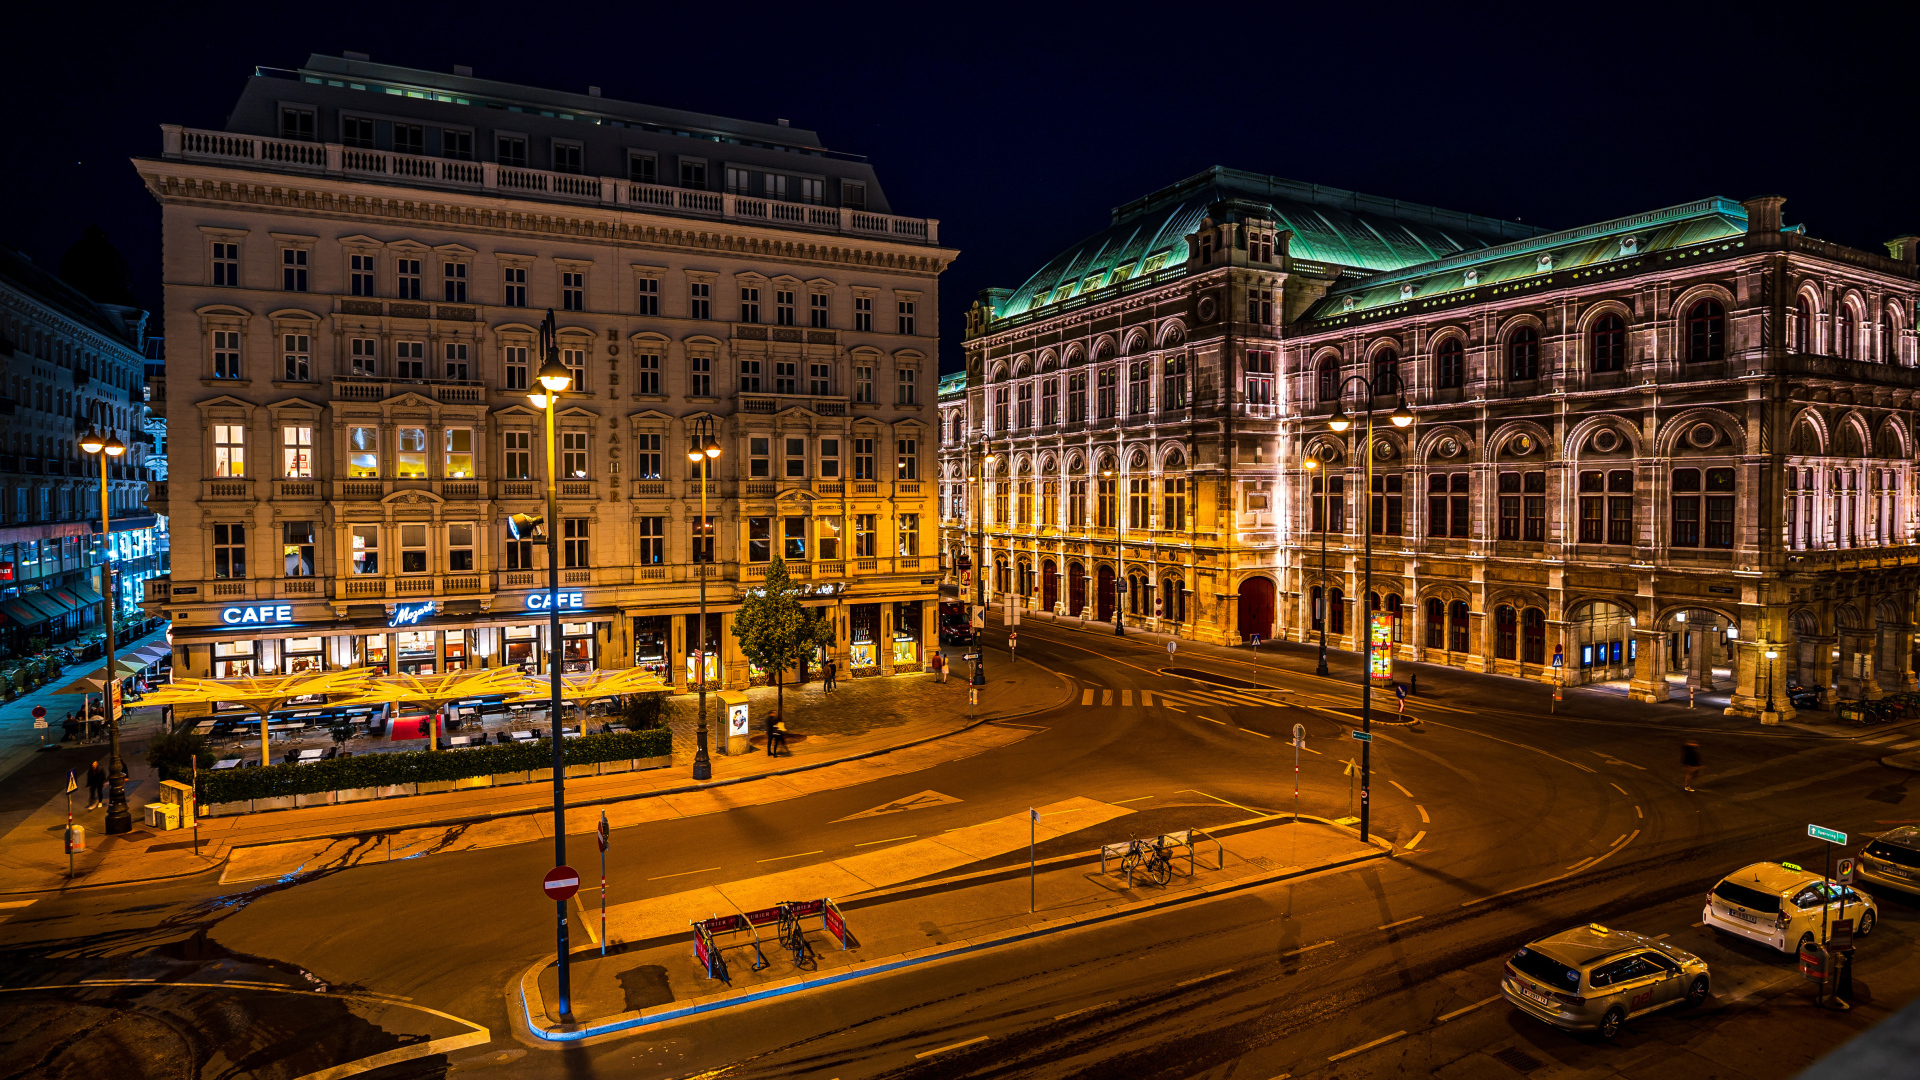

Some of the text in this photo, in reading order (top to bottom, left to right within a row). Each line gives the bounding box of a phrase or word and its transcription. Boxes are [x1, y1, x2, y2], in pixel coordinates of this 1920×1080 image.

[608, 329, 621, 503] HOTEL SACHER
[527, 593, 583, 609] CAFE
[223, 605, 292, 624] CAFE
[389, 601, 434, 627] Mozart
[748, 911, 770, 920] URIER
